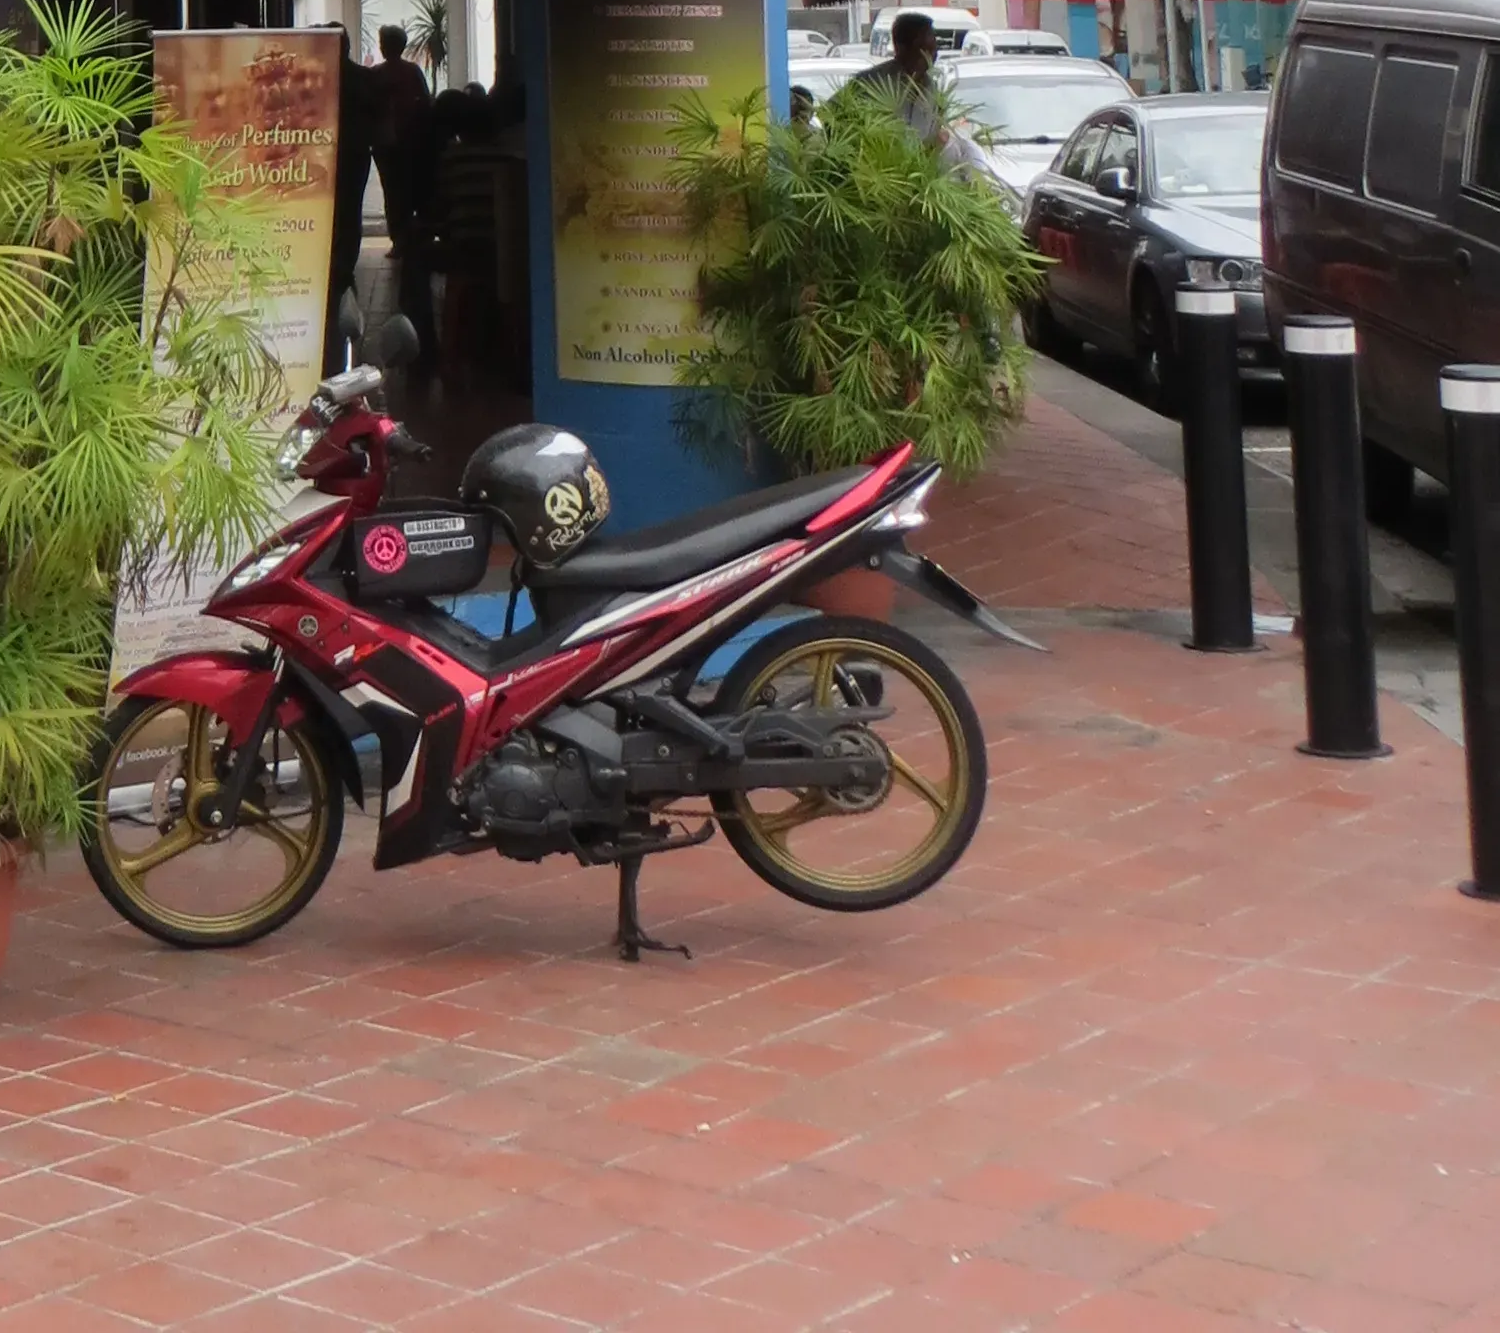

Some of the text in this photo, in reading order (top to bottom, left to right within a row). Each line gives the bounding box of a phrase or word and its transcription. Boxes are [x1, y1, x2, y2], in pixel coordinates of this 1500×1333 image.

[242, 121, 334, 147] Perfumes
[248, 160, 314, 185] World.
[614, 286, 663, 298] SANDAL
[616, 322, 661, 334] YLANG
[573, 343, 602, 361] Non
[605, 345, 685, 365] Alcoholic
